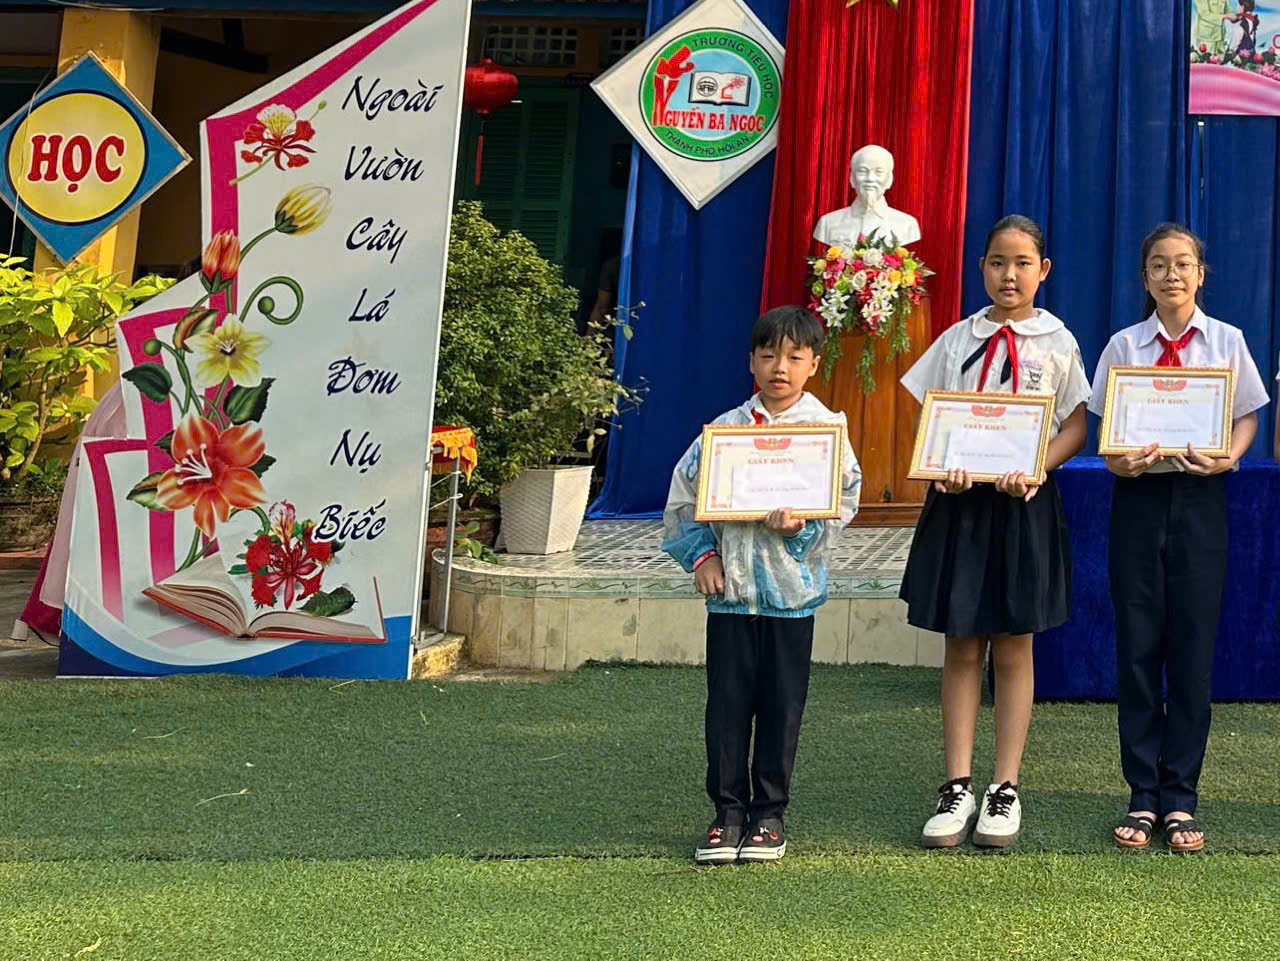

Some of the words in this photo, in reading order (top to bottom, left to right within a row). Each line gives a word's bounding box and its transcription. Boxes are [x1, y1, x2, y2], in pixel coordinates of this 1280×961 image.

[342, 75, 443, 121] Ngoài
[737, 136, 750, 147] AN
[26, 134, 125, 193] HỌC
[344, 145, 423, 182] Vườn
[346, 216, 408, 264] Cây
[348, 288, 396, 323] Lá
[327, 356, 401, 396] Đơm
[330, 429, 381, 474] Nụ
[314, 499, 387, 541] Biếc
